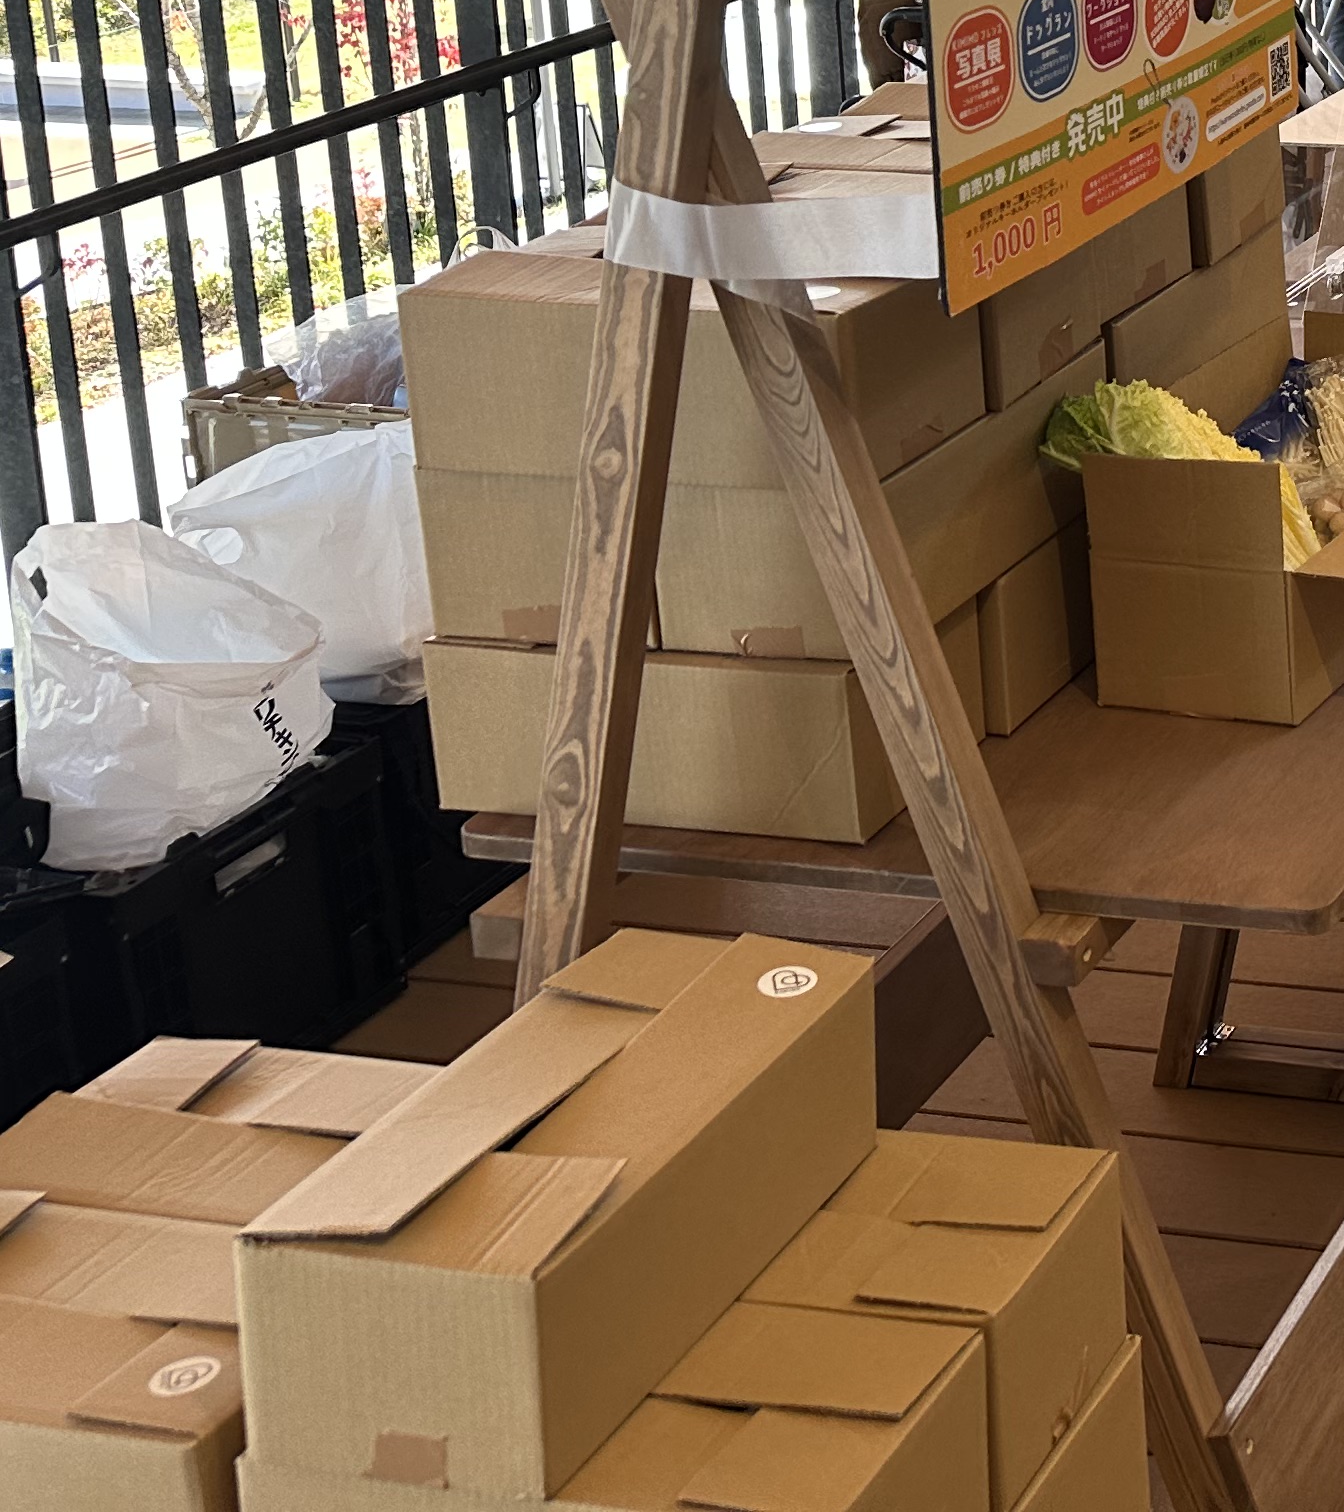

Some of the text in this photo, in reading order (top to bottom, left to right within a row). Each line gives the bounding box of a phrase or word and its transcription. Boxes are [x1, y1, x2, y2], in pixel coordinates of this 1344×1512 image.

[1026, 10, 1072, 46] ドッグラン
[955, 38, 1002, 79] 写真展
[1065, 92, 1125, 157] 発売中
[972, 202, 1062, 279] 1,000 円
